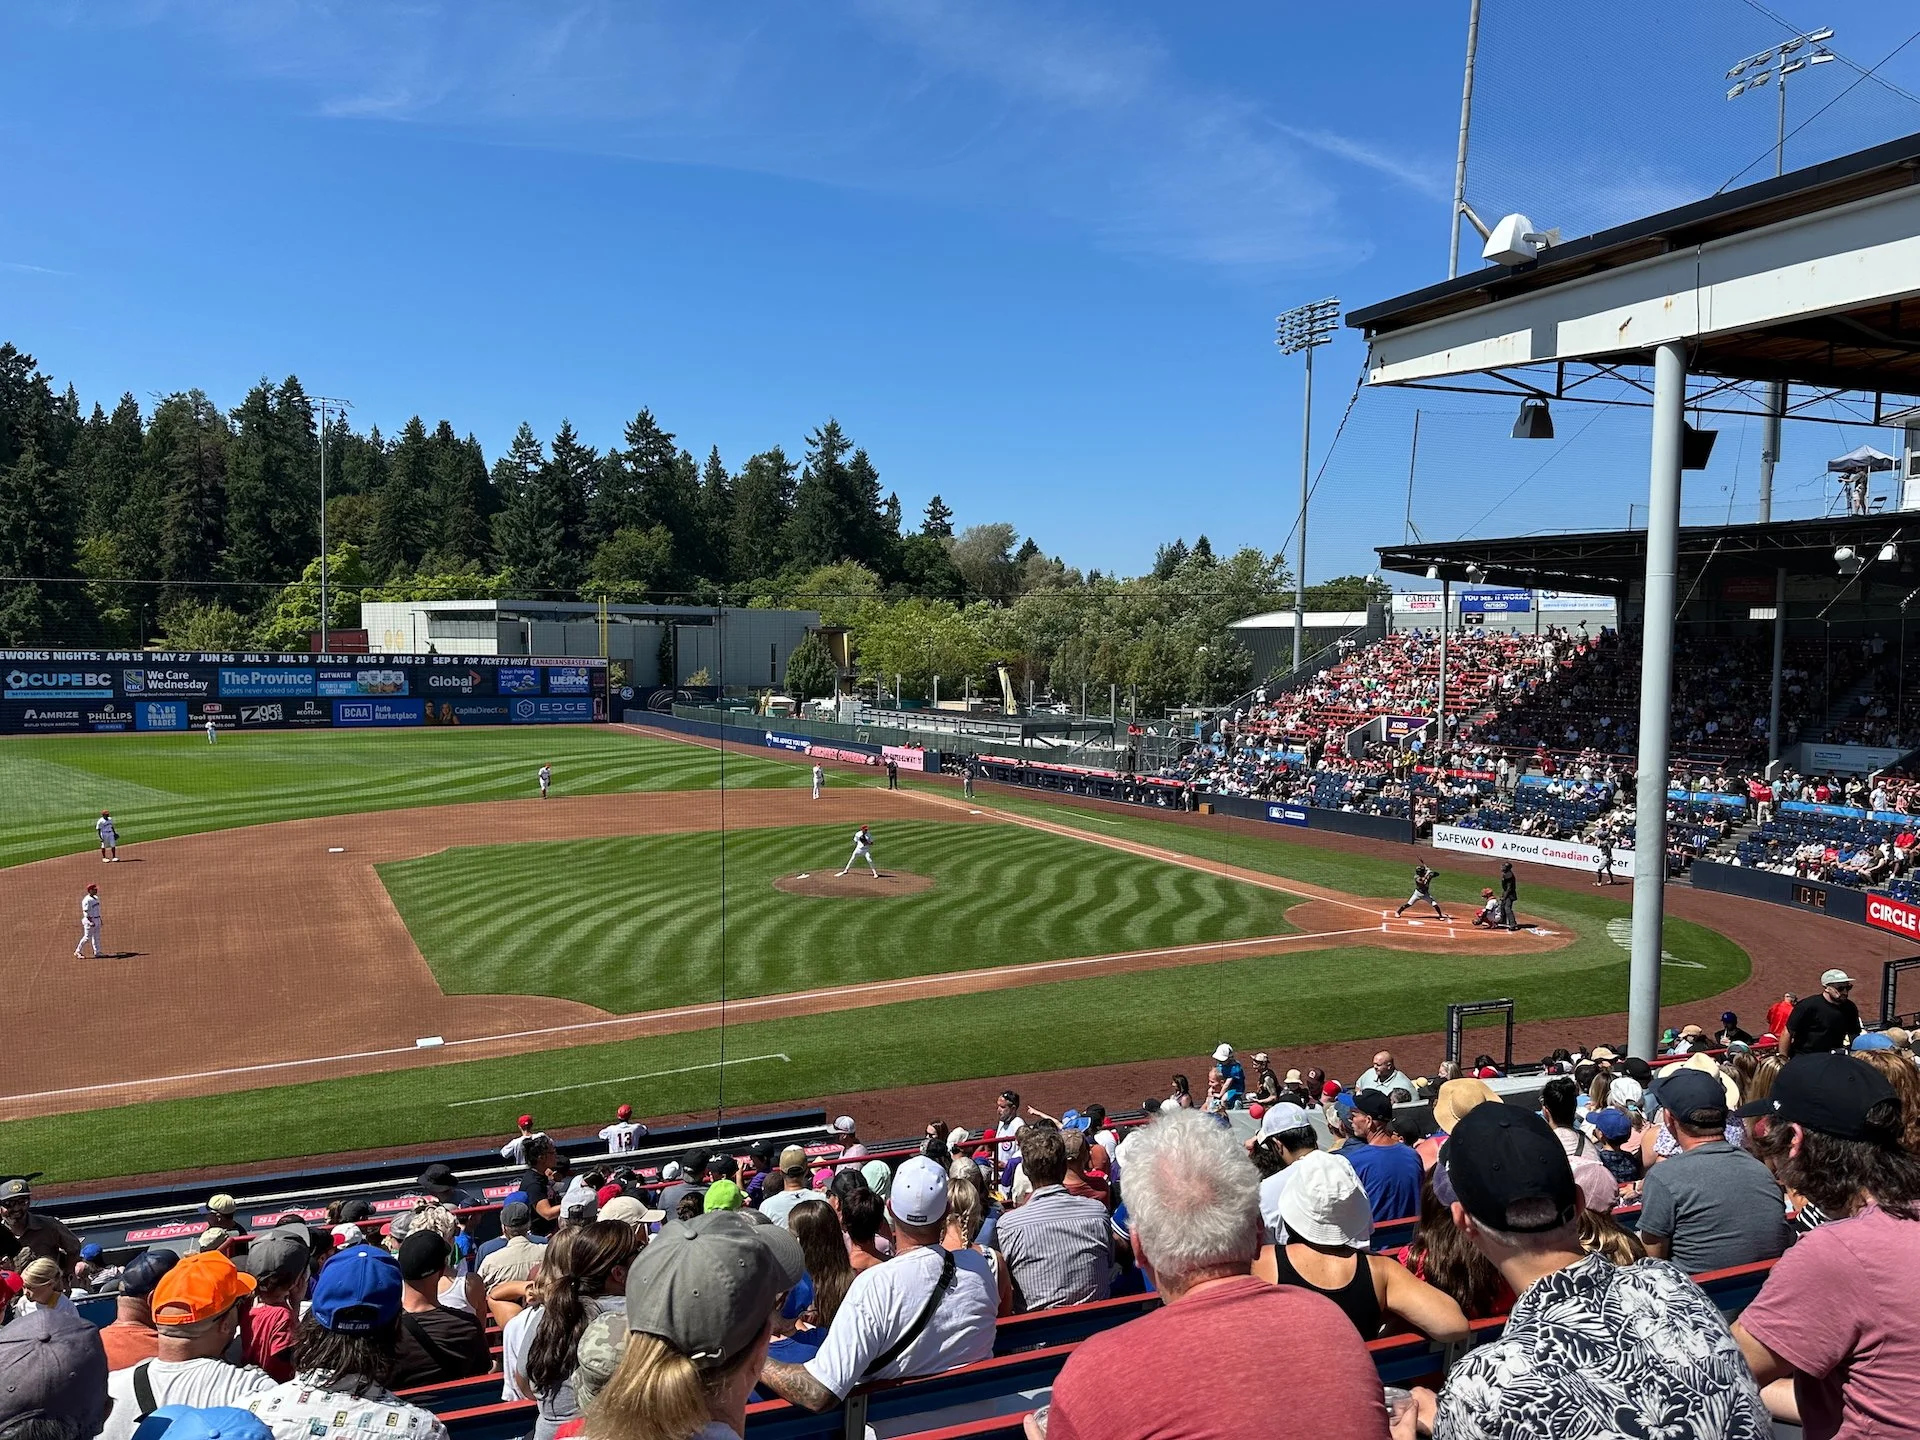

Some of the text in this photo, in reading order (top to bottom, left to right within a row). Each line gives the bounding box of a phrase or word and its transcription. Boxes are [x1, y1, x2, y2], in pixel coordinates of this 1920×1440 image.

[1405, 594, 1441, 602] CARTER
[53, 651, 100, 661] NIGHTS:
[106, 652, 130, 661] APR
[132, 653, 143, 661] 15
[152, 653, 176, 661] MAY
[199, 654, 220, 662] JUN
[222, 654, 235, 662] 26
[242, 654, 262, 662] JUL
[277, 655, 296, 663] JUL
[298, 655, 309, 663] 19
[316, 655, 335, 663] JUL
[356, 656, 377, 664] AUG
[392, 656, 413, 664] AUG
[480, 657, 508, 665] TICKETS
[510, 658, 528, 666] VISIT
[147, 670, 189, 679] We Care
[222, 671, 313, 685] The Province
[28, 673, 112, 687] CUPE BC
[428, 675, 473, 687] Global
[549, 676, 589, 685] WESPAC
[147, 680, 209, 691] Wednesday
[461, 686, 473, 694] BC
[222, 687, 243, 695] Sports
[374, 704, 391, 712] Auto
[539, 703, 587, 711] EDGE
[39, 711, 79, 719] AMRIZE
[87, 712, 133, 720] PHILLIPS
[344, 707, 368, 718] BCAA
[374, 712, 417, 721] Marketplace
[147, 719, 177, 727] TRADES
[1391, 721, 1408, 729] KISS
[1437, 831, 1481, 847] SAFEWAY
[1501, 842, 1629, 868] A Proud Canadian Gcer
[1869, 902, 1917, 931] CIRCLE
[617, 1131, 632, 1147] 13
[133, 1225, 203, 1238] SLEEMAN
[337, 1322, 354, 1330] BLUE
